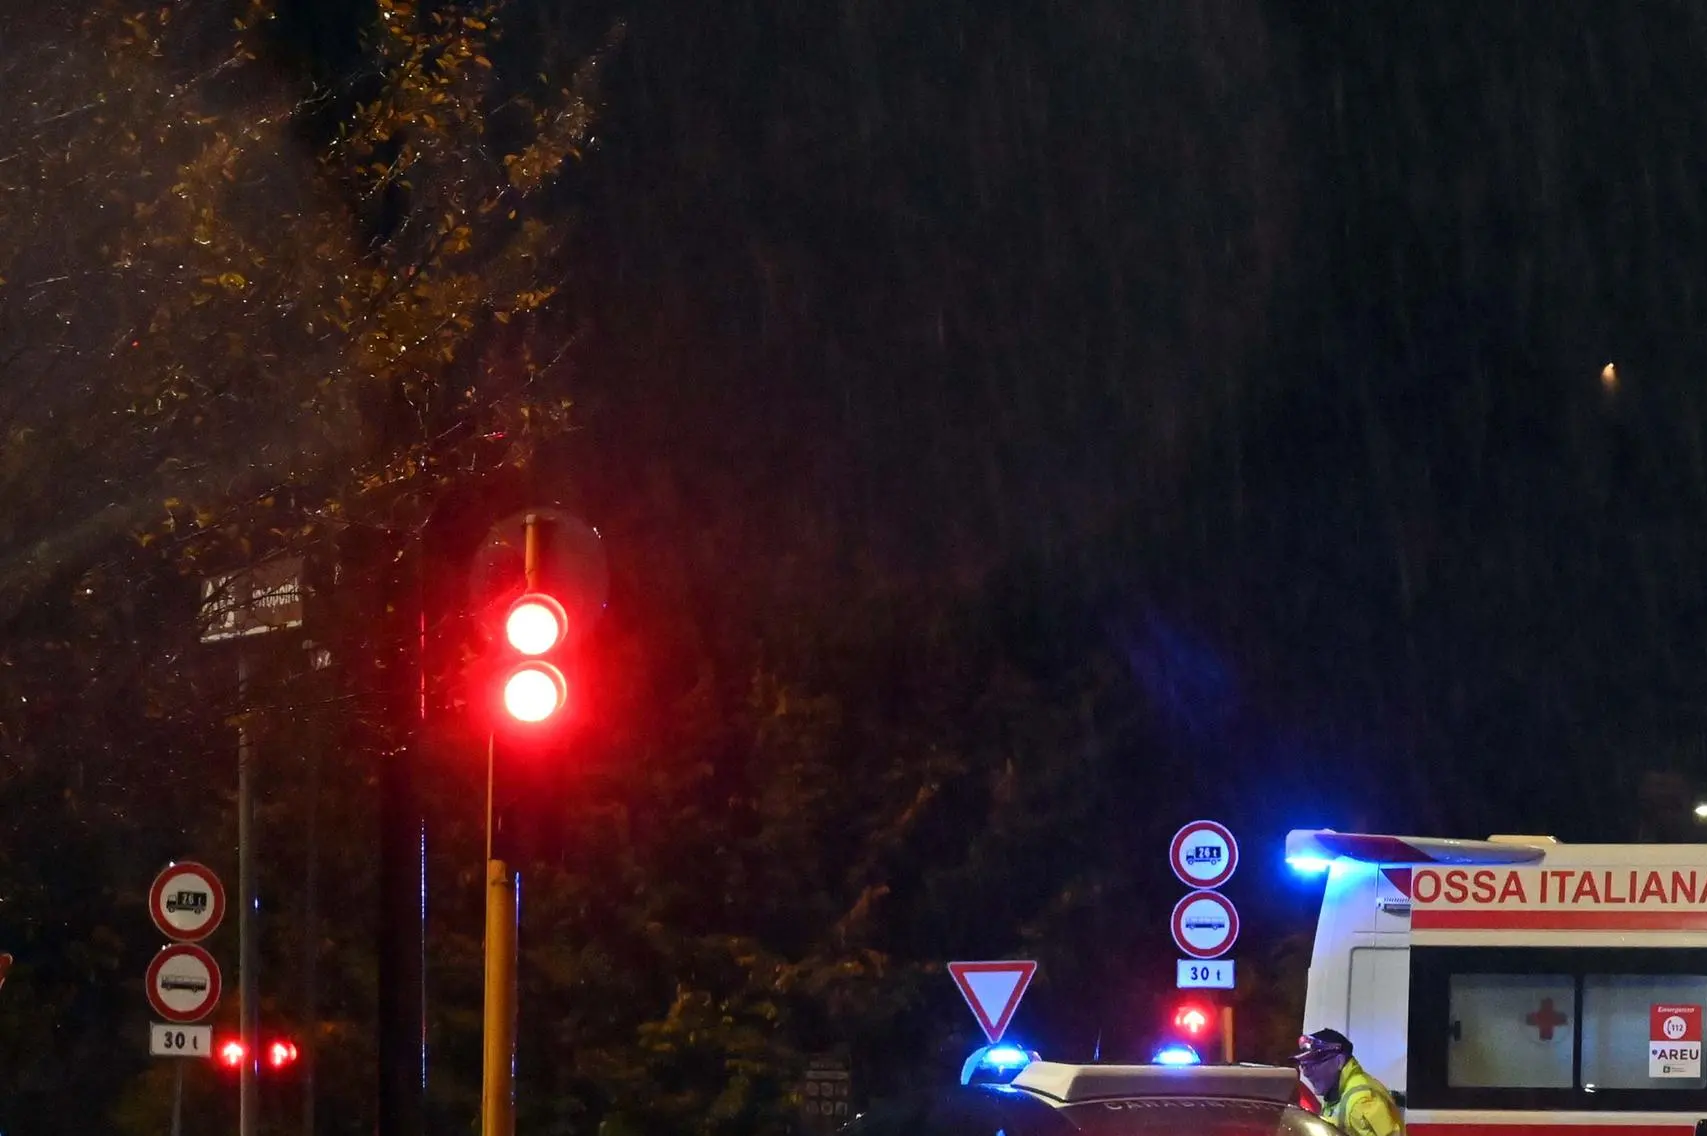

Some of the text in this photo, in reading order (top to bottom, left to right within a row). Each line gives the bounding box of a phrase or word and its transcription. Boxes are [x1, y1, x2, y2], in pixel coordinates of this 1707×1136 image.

[1412, 870, 1528, 904] OSSA
[1190, 966, 1221, 981] 30 t
[1671, 1024, 1684, 1032] 112
[163, 1031, 198, 1050] 30 t
[1657, 1048, 1699, 1060] AREU
